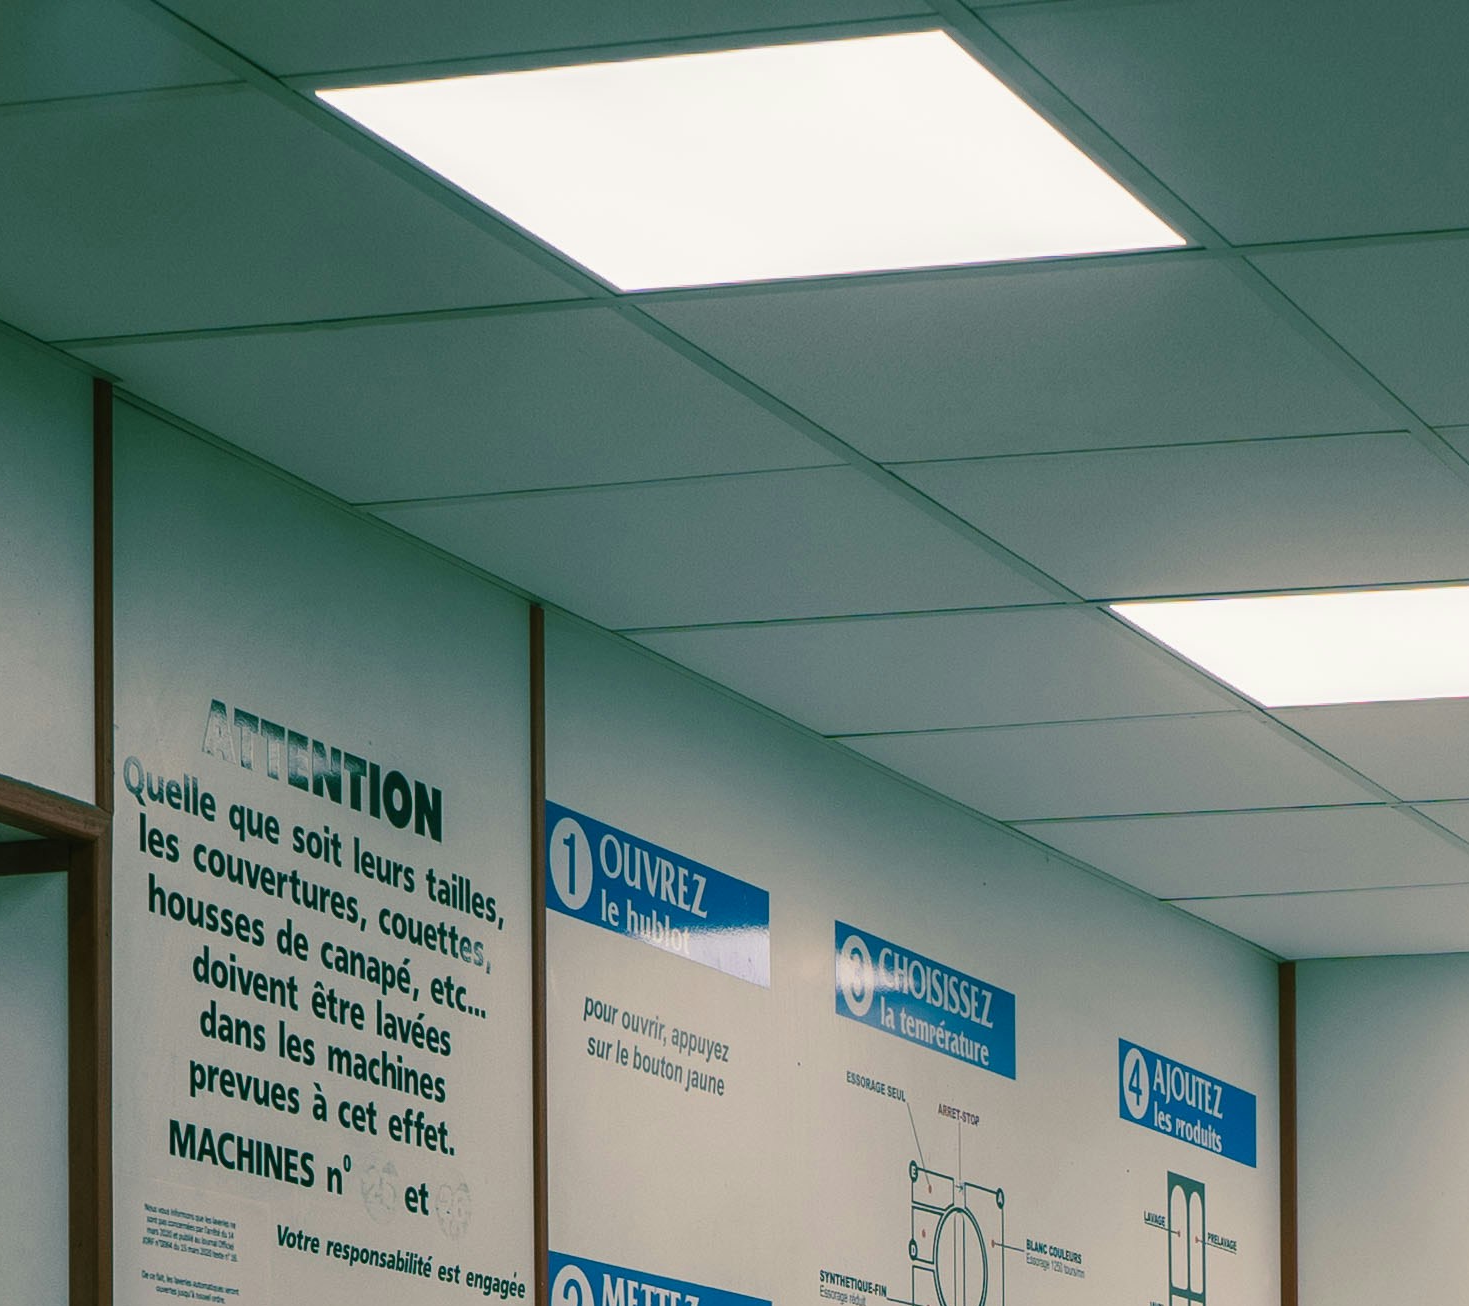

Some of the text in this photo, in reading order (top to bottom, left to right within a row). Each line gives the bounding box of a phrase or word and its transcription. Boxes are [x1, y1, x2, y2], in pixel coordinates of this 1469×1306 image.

[201, 698, 442, 844] ATTENTION
[122, 755, 505, 931] Quelle que soit leurs tailles,
[562, 832, 707, 919] 1 OUVREZ
[139, 812, 491, 975] les couvertures, couettes,
[601, 889, 690, 955] le hublot
[148, 873, 486, 1019] housses de canapé, etc...
[192, 945, 451, 1057] doivent être lavées
[850, 944, 993, 1029] 3 CHOISISSEZ
[200, 1000, 446, 1103] dans les machines
[583, 995, 729, 1063] pour ouvrir, appuyez
[881, 997, 990, 1067] la température
[587, 1036, 724, 1097] sur le bouton jaune
[846, 1071, 907, 1103] ESSORAGE SEUL
[1128, 1058, 1223, 1119] 4 AJOUTEZ
[189, 1059, 455, 1156] prevues à cet effet.
[937, 1103, 980, 1127] ARRET-STOP
[1154, 1101, 1222, 1153] les produits
[169, 1119, 315, 1189] MACHINES
[404, 1183, 429, 1216] et
[1026, 1239, 1082, 1265] BLANC COULEURS
[1144, 1211, 1166, 1228] LAVAGE
[1207, 1232, 1237, 1251] PRELAVAGE
[276, 1224, 526, 1300] Votre responsabilité est engagée
[819, 1269, 887, 1298] SYNTHETIQUE-FIN
